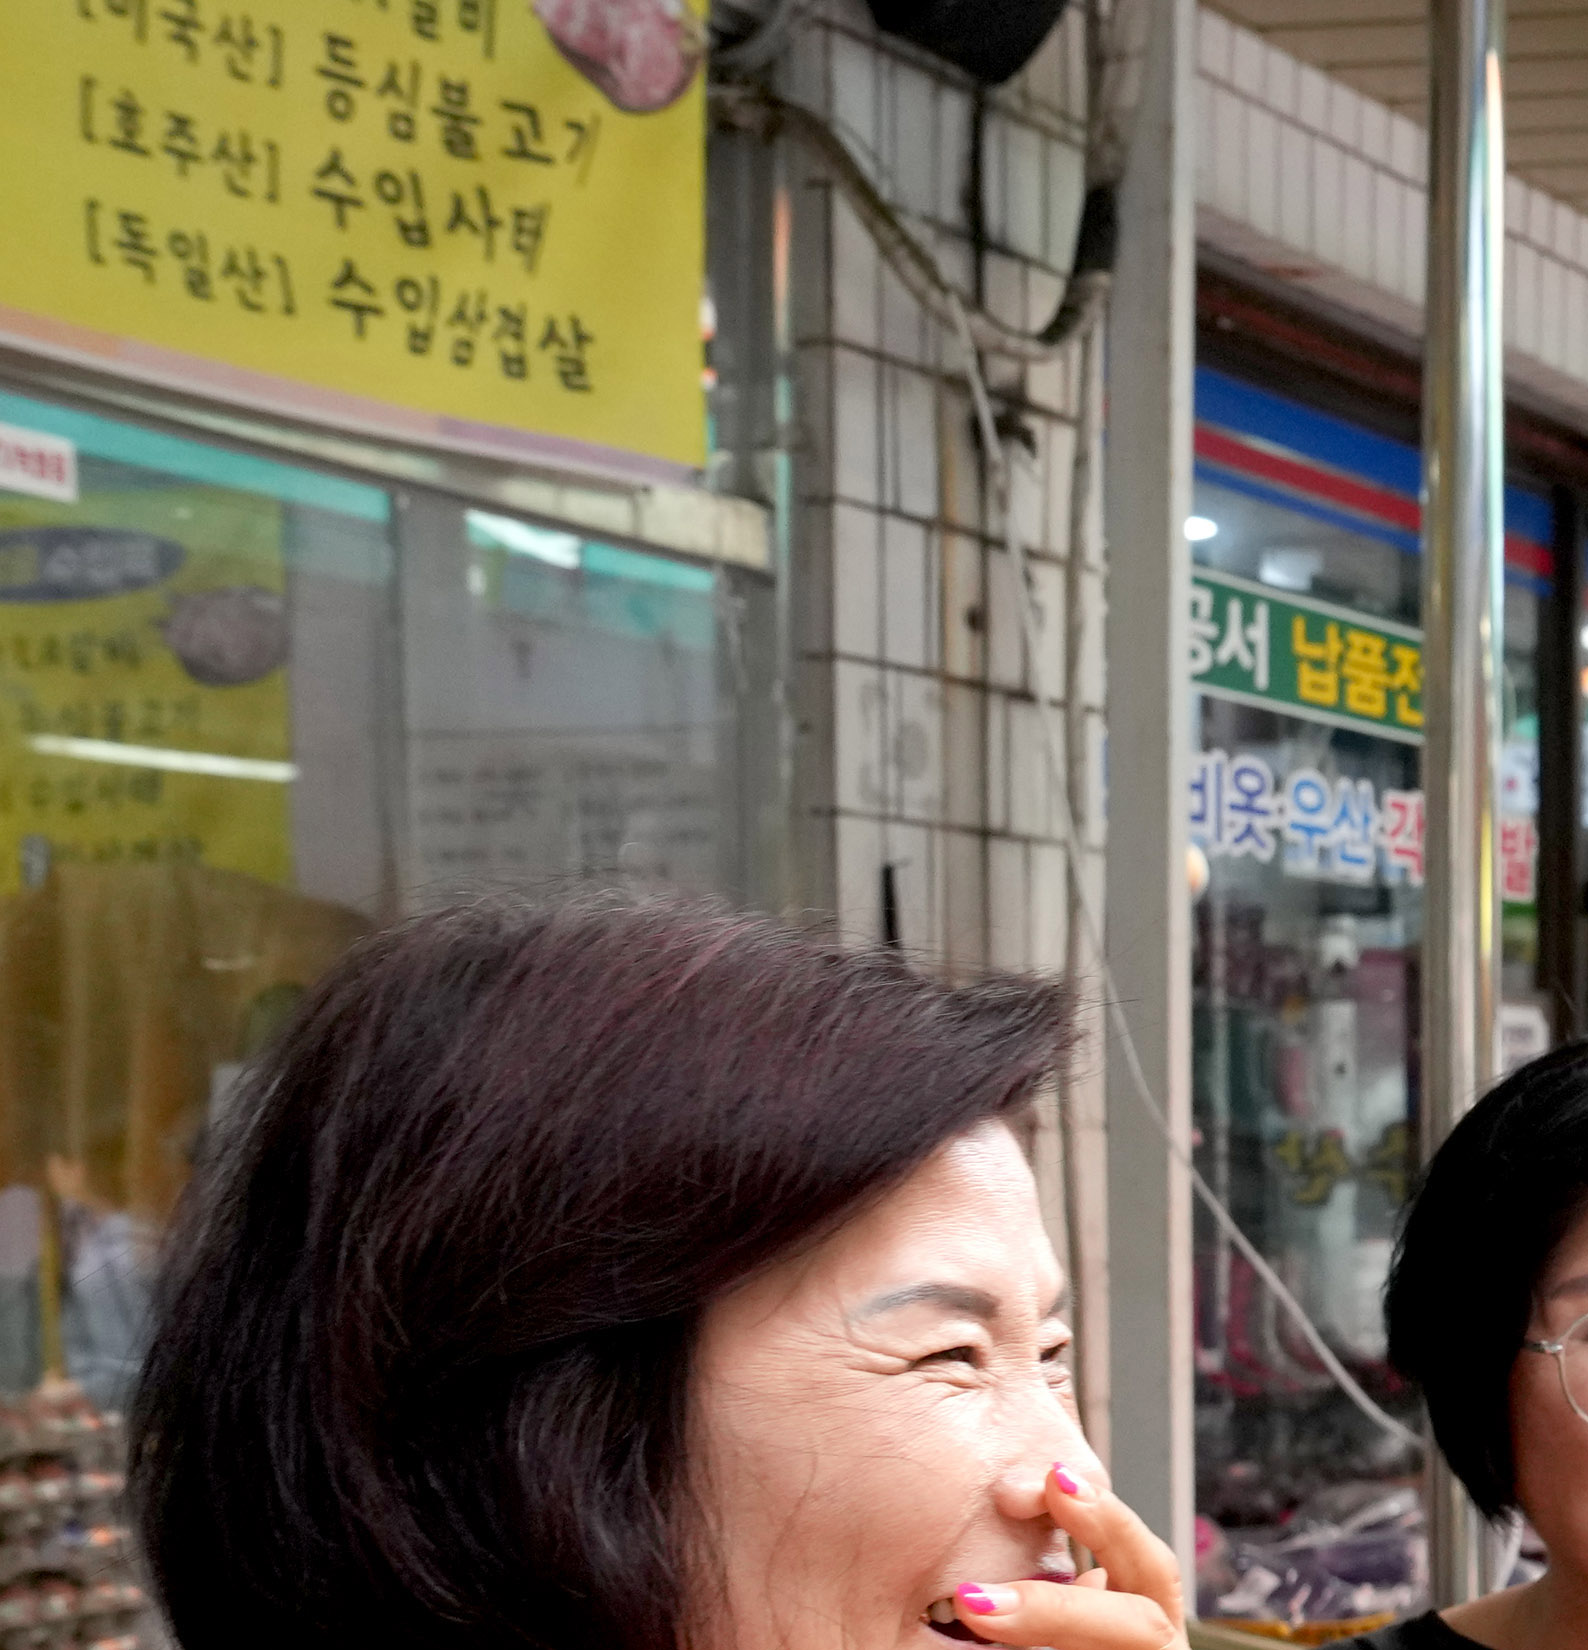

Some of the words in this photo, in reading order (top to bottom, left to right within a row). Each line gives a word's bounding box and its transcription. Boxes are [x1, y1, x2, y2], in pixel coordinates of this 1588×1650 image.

[81, 73, 283, 204] [호주산]
[314, 30, 602, 187] 등심불고기
[84, 198, 297, 316] [독일산]
[1288, 777, 1369, 868] 우산
